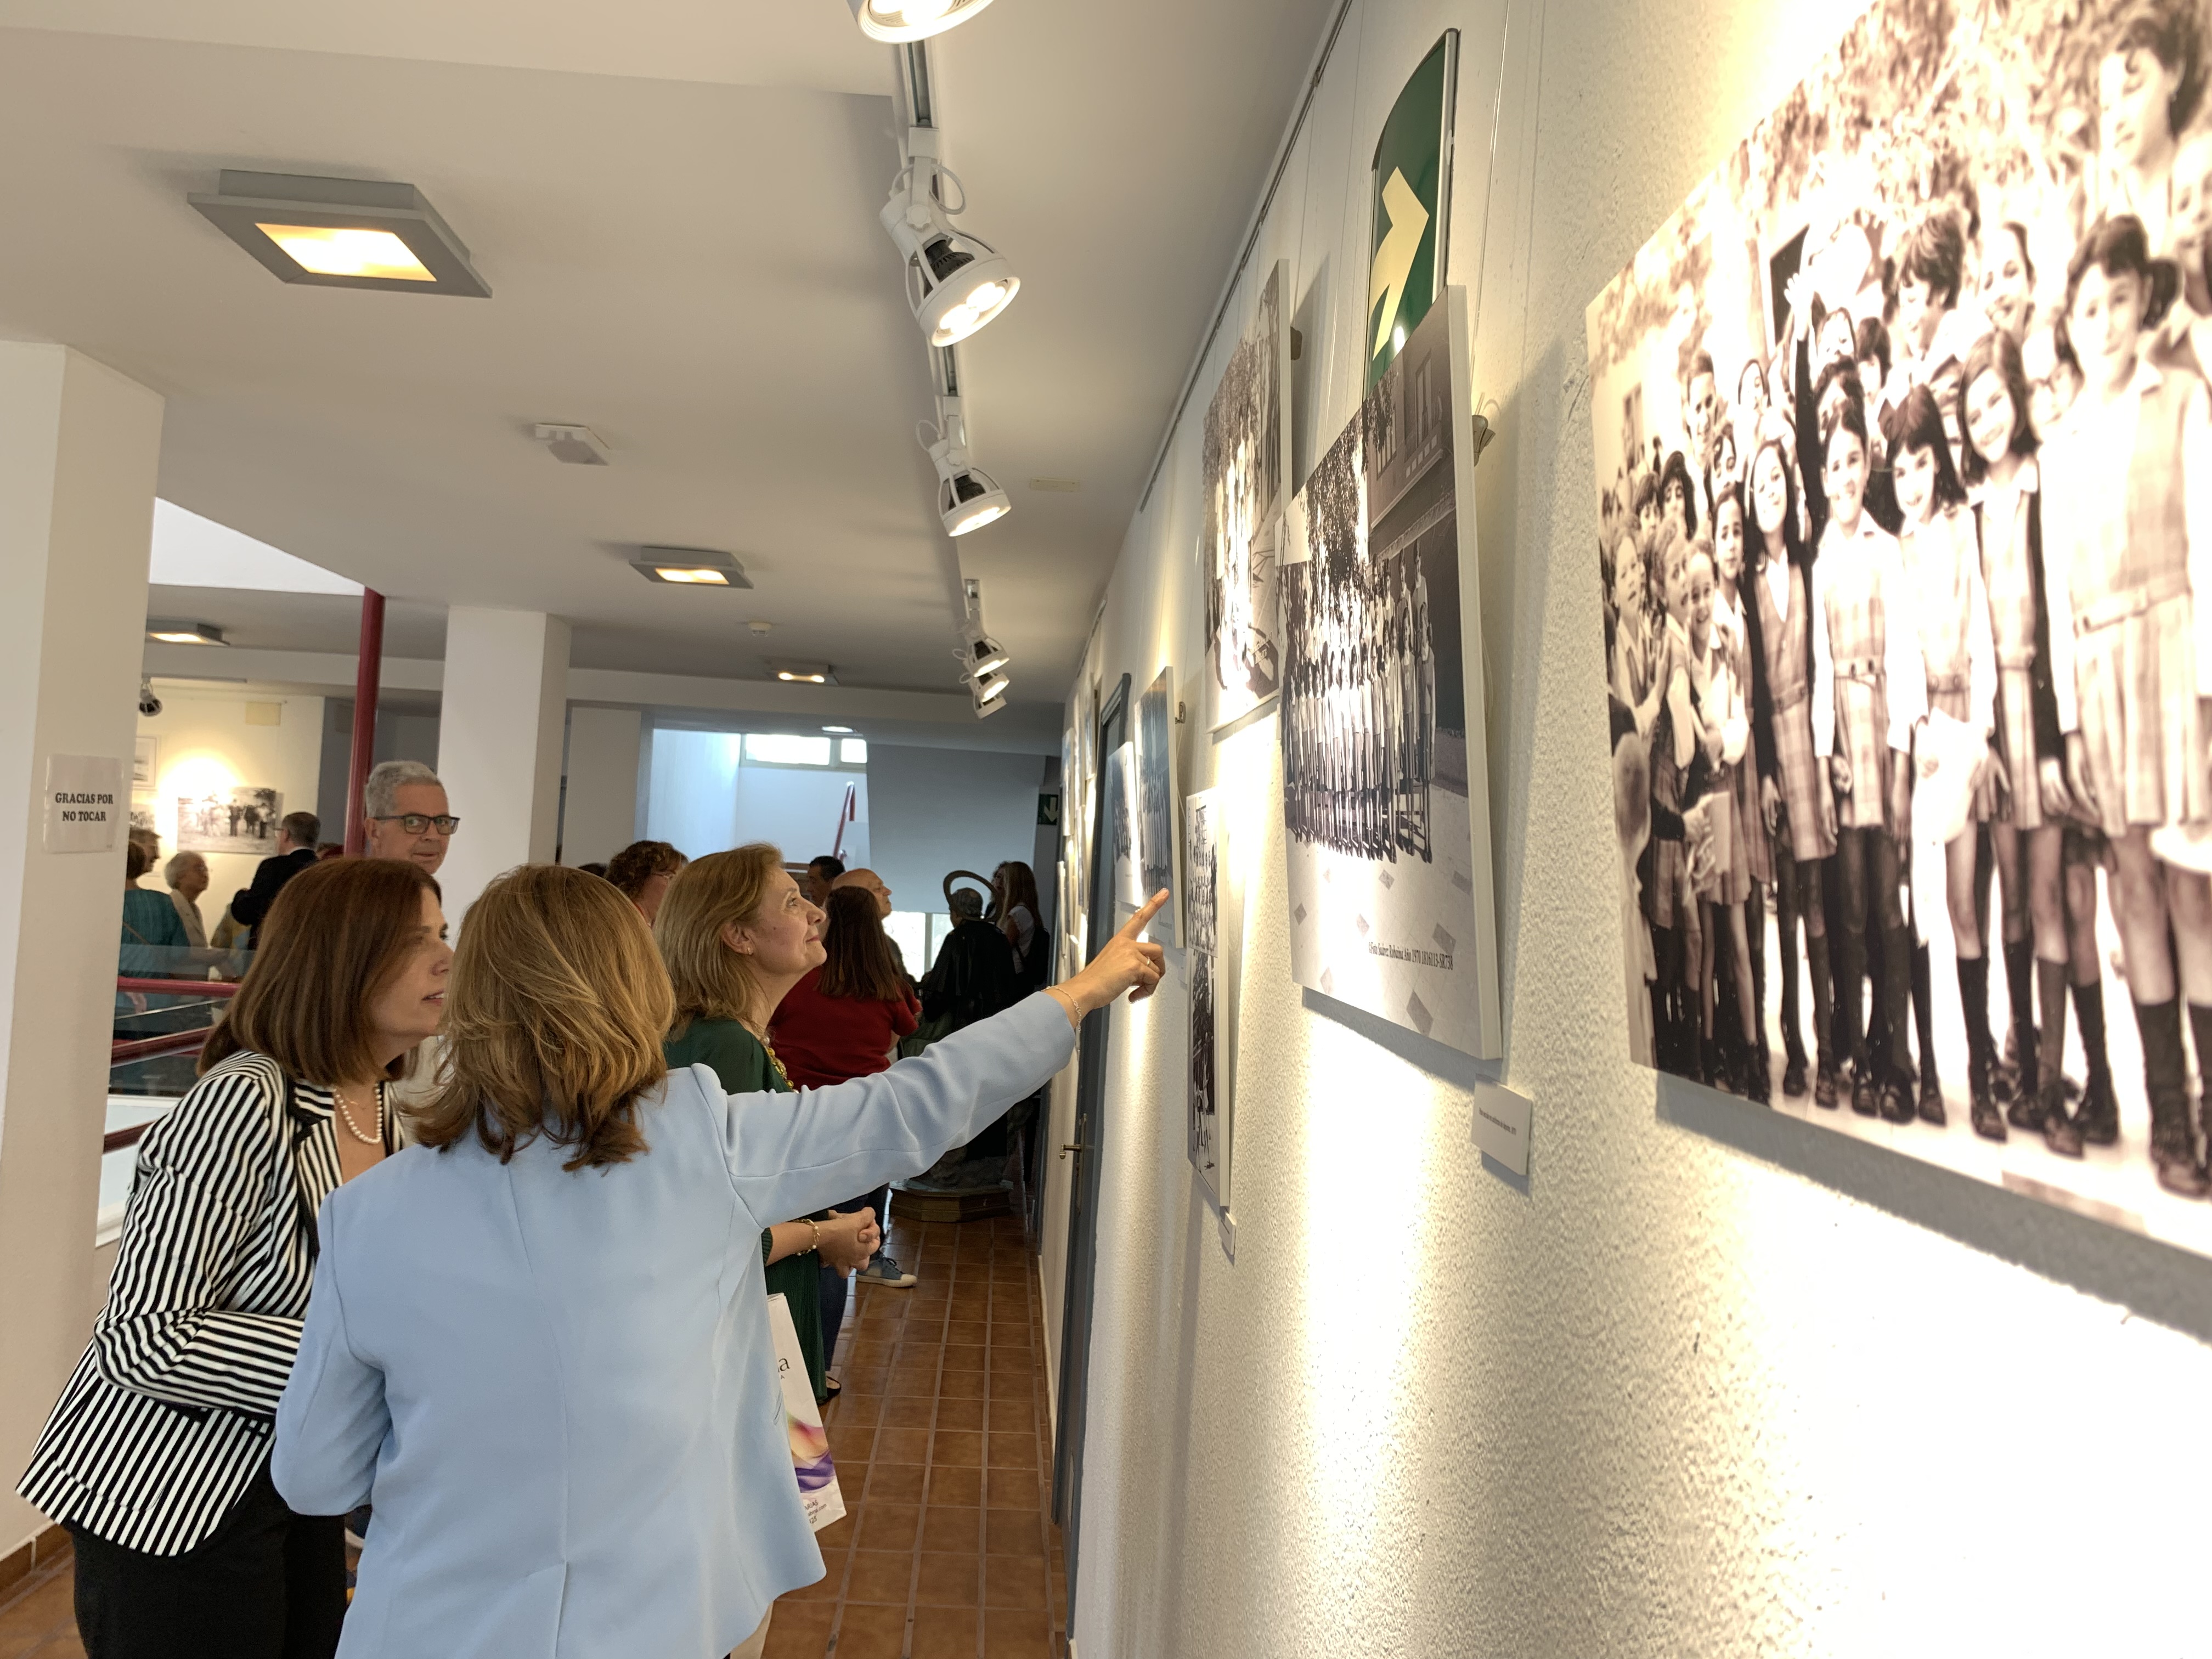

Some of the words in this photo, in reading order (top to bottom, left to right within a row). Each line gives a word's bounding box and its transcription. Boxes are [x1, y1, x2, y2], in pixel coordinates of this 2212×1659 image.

[55, 793, 95, 804] GRACIAS
[97, 794, 114, 805] POR
[62, 811, 76, 822] NO
[78, 811, 106, 822] TOCAR
[1412, 949, 1421, 964] 1970
